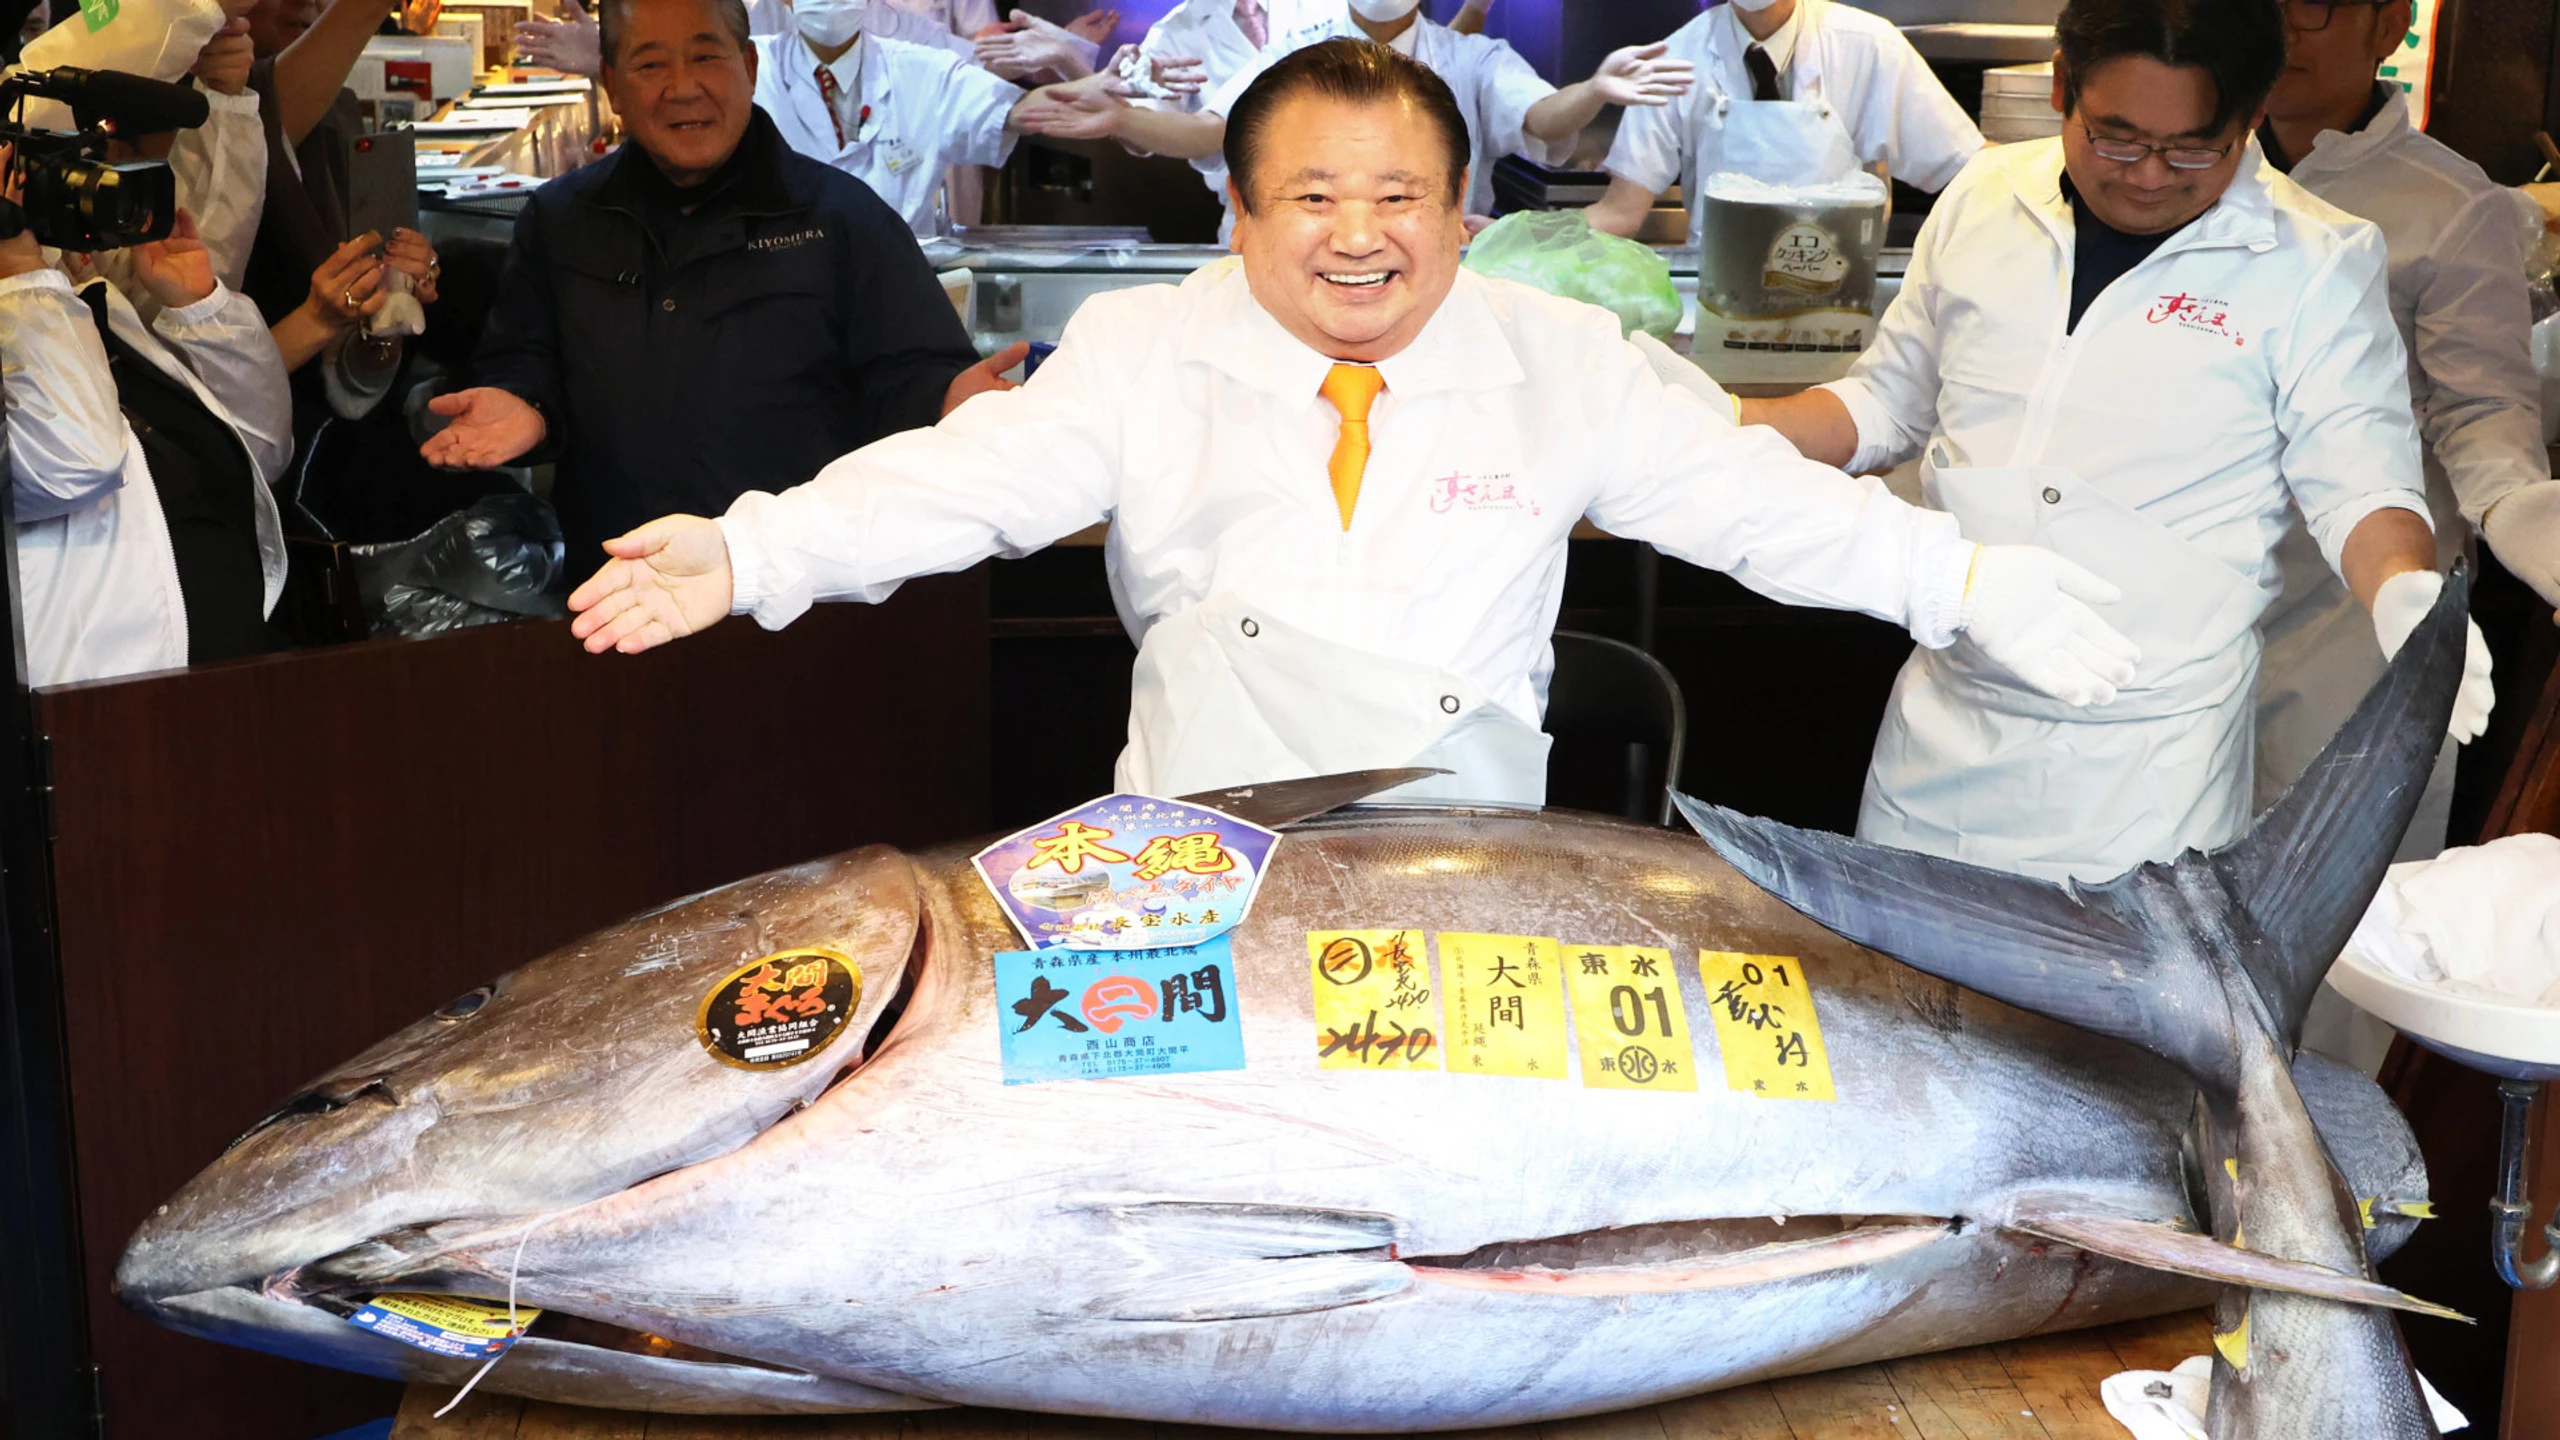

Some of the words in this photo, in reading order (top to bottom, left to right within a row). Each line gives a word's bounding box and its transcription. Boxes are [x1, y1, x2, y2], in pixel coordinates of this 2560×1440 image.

[747, 229, 825, 251] KIYOMURA
[1789, 235, 1819, 248] エコ
[1776, 247, 1834, 263] クッキング
[1032, 953, 1100, 970] 青森県産
[1524, 941, 1542, 986] 青森県
[739, 959, 828, 997] 大間
[1742, 963, 1790, 987] 01
[1486, 955, 1527, 1031] 大間
[1610, 985, 1673, 1038] 01
[1085, 1035, 1155, 1050] 西山商店
